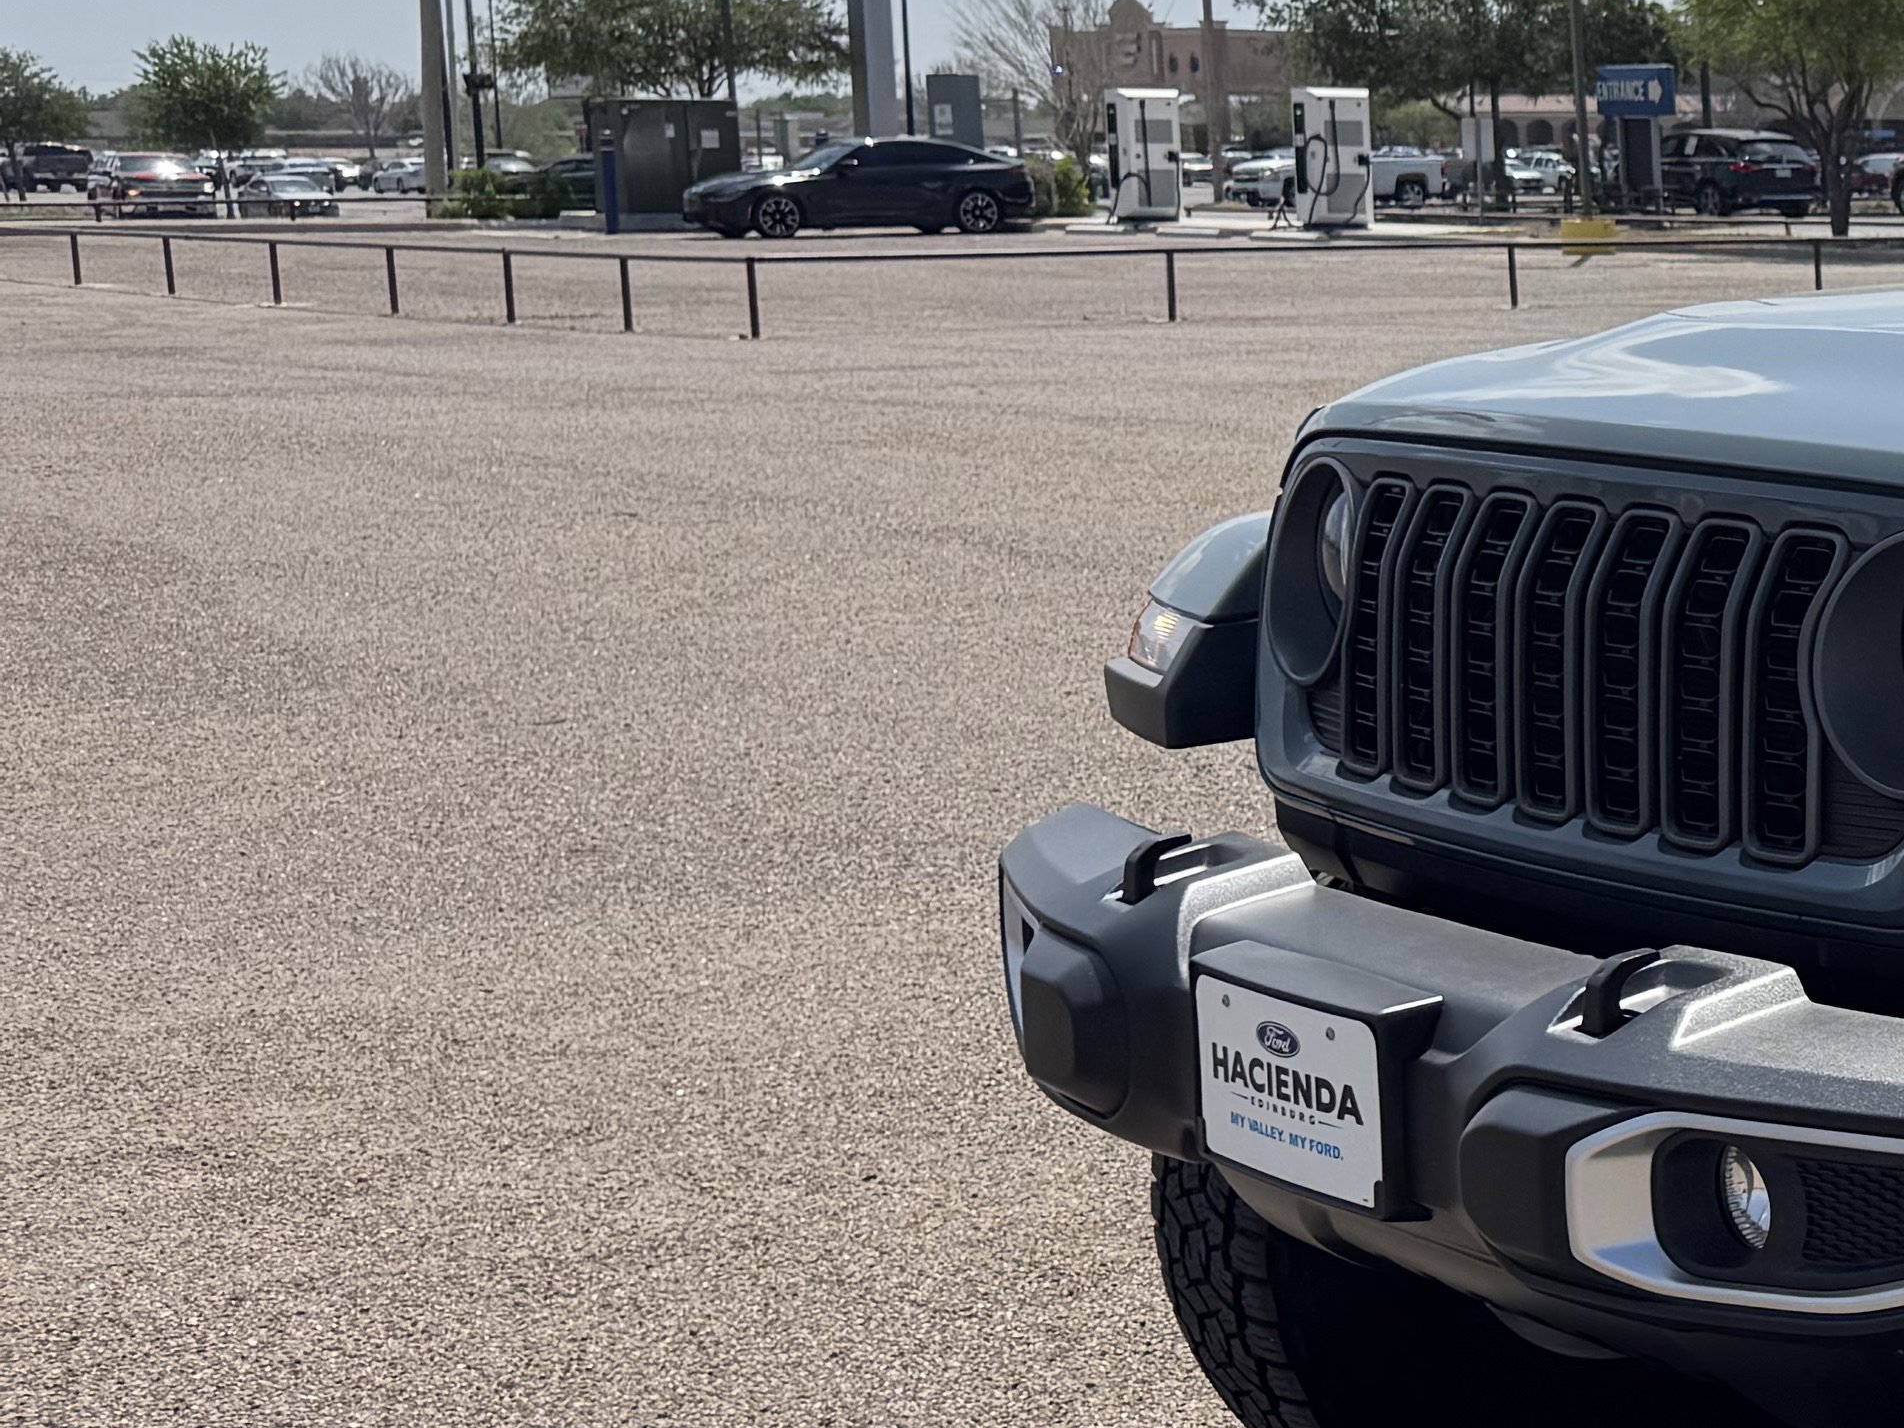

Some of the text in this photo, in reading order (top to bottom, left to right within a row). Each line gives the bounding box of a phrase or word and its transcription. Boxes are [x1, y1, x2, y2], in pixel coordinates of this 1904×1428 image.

[1597, 80, 1645, 103] ENTRANCE
[1211, 1042, 1364, 1126] HACIENDA
[1251, 1095, 1316, 1125] EDINBURG
[1230, 1110, 1246, 1128] MY
[1288, 1132, 1308, 1150] MY
[1308, 1138, 1344, 1161] FORD.
